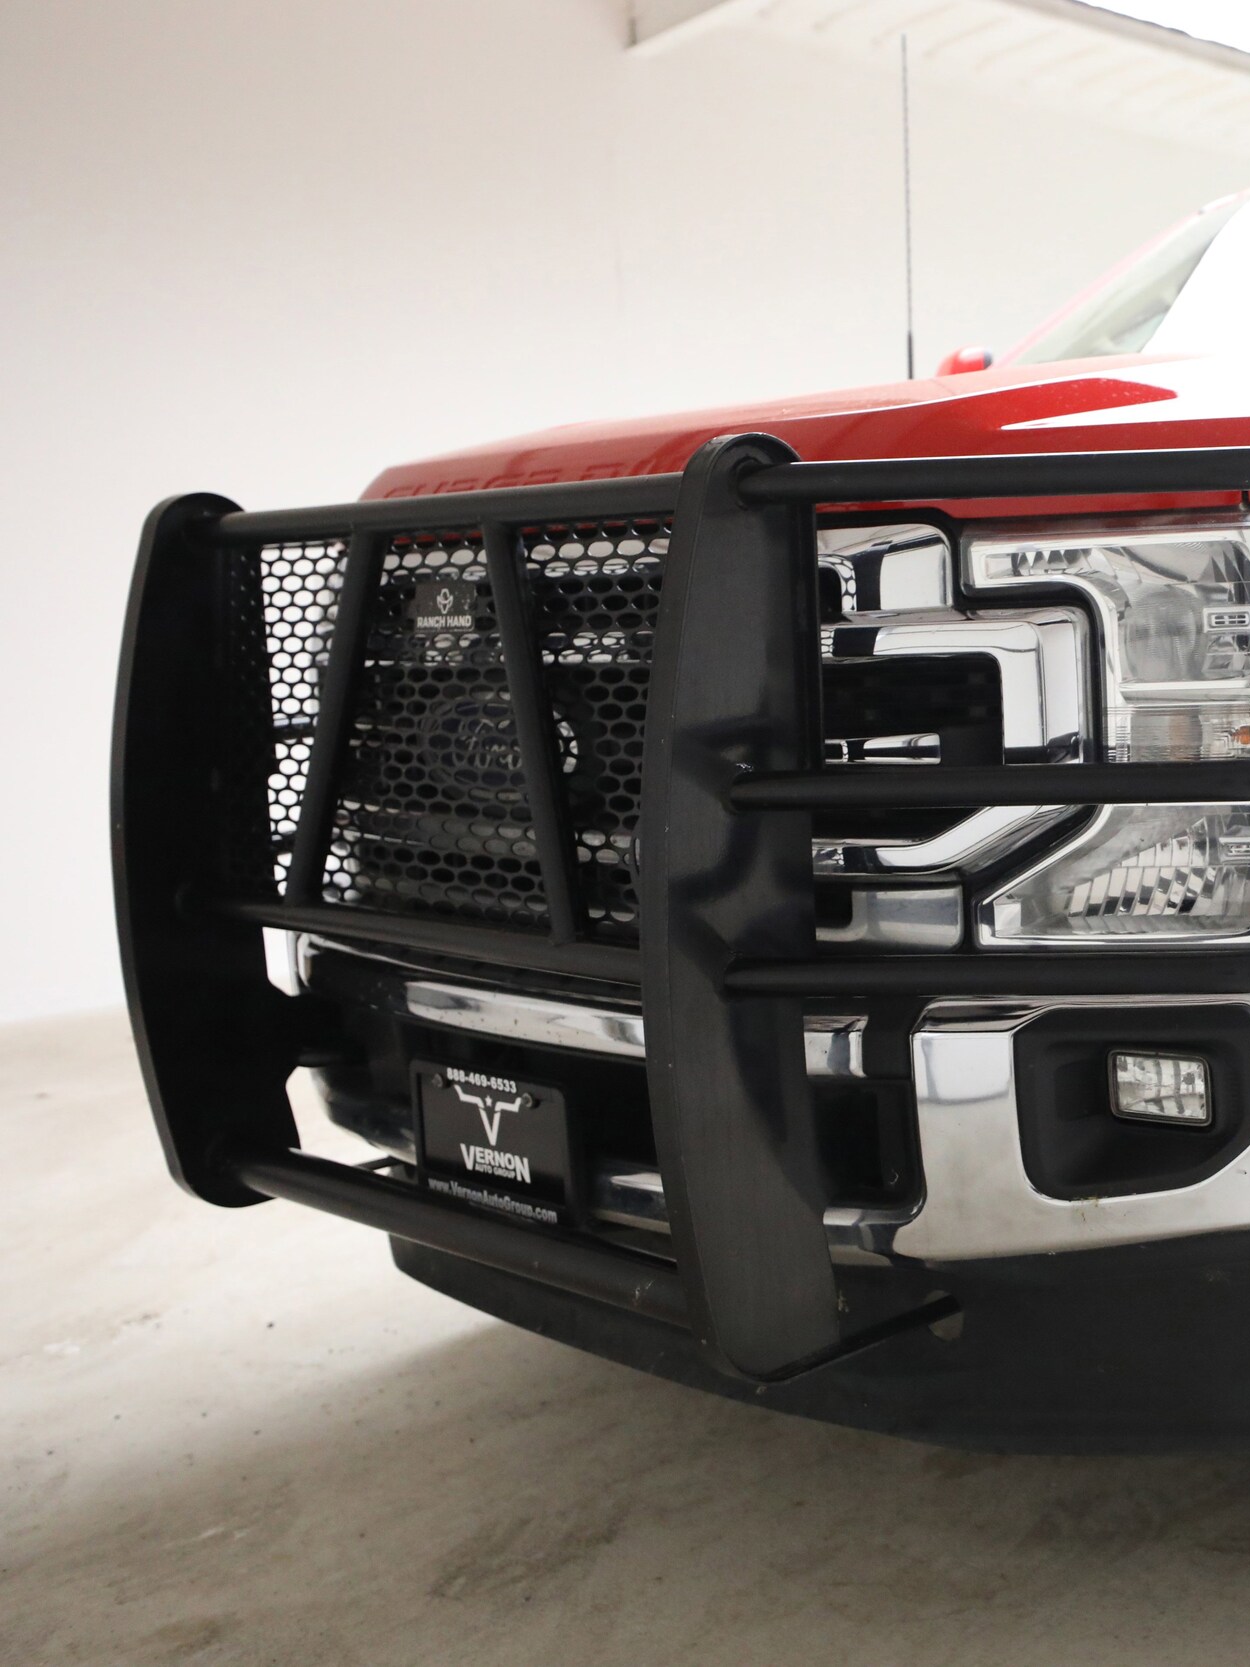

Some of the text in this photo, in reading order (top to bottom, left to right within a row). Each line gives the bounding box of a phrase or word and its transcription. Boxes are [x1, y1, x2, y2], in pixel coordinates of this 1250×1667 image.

[416, 615, 472, 629] RANCH HAND
[447, 1068, 517, 1093] 888-469-6533
[460, 1143, 531, 1183] VERNON
[474, 1163, 516, 1179] AUTO GROUP
[428, 1178, 557, 1223] www.VernonAutoGroup.com
